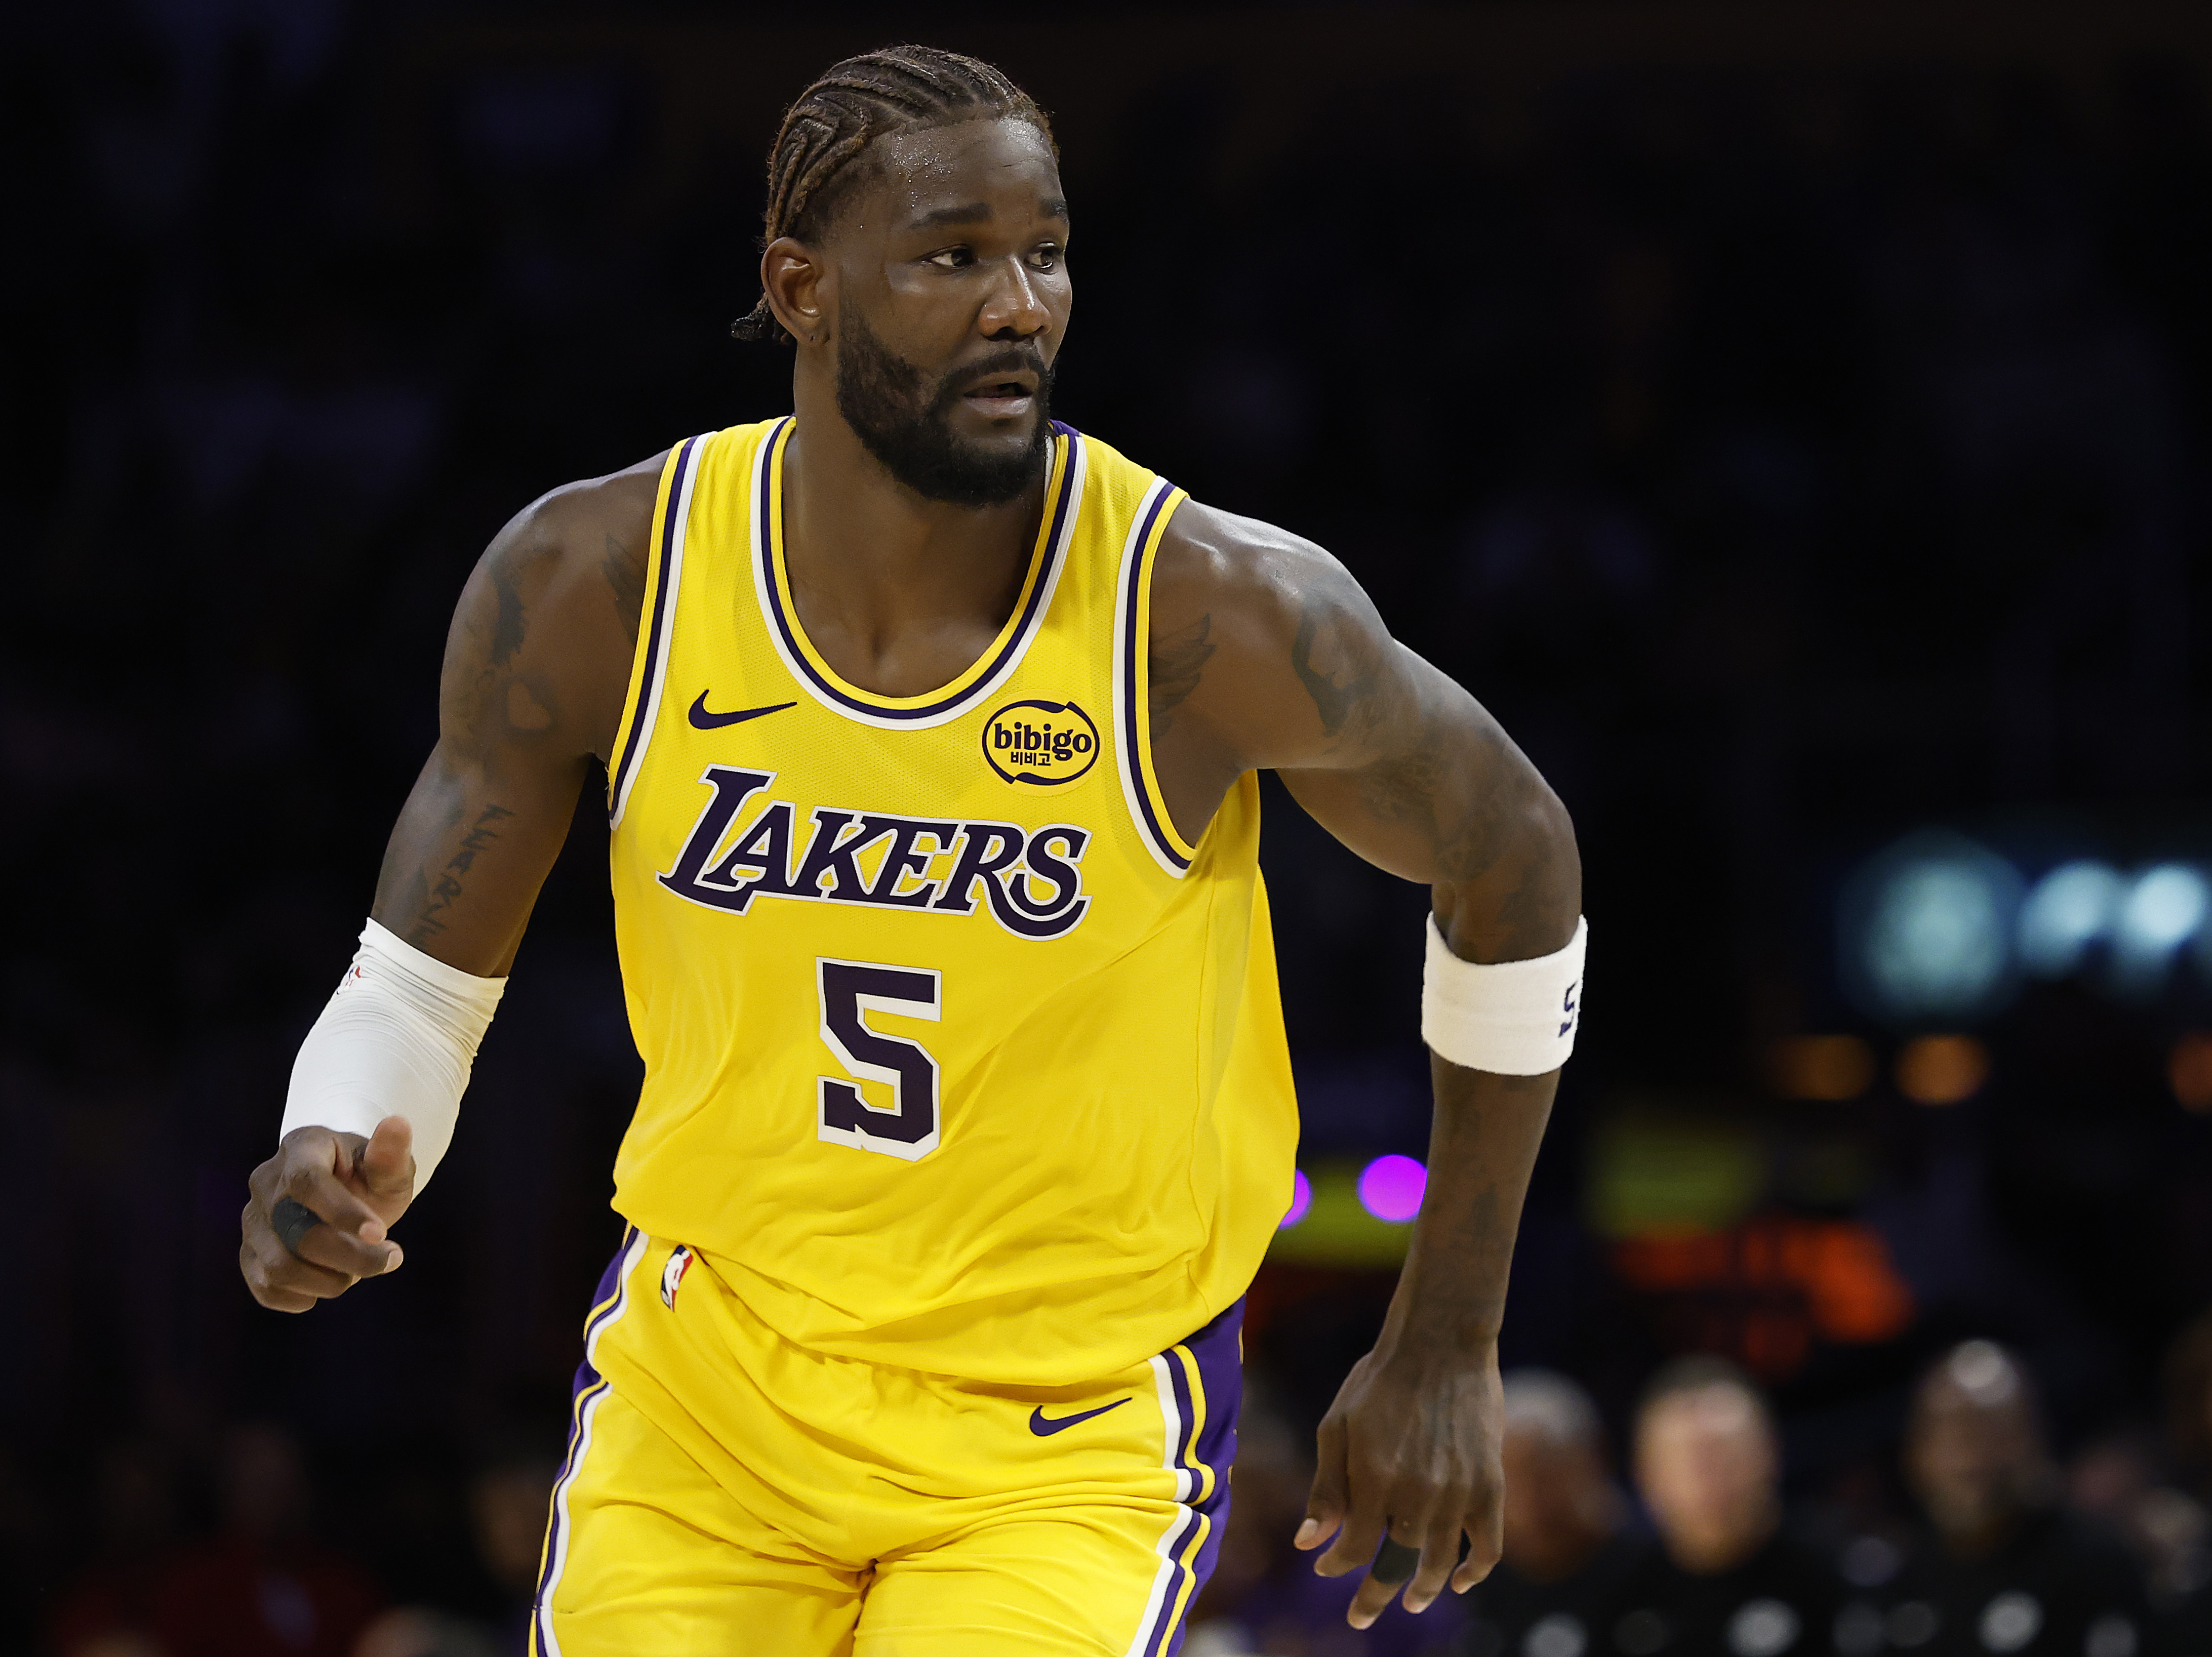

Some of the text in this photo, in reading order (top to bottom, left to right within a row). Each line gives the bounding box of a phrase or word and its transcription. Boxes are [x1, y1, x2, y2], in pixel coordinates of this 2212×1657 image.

[994, 721, 1092, 761] bibigo
[1011, 752, 1051, 766] 비비고
[656, 763, 1093, 942] LAKERS
[816, 956, 942, 1162] 5
